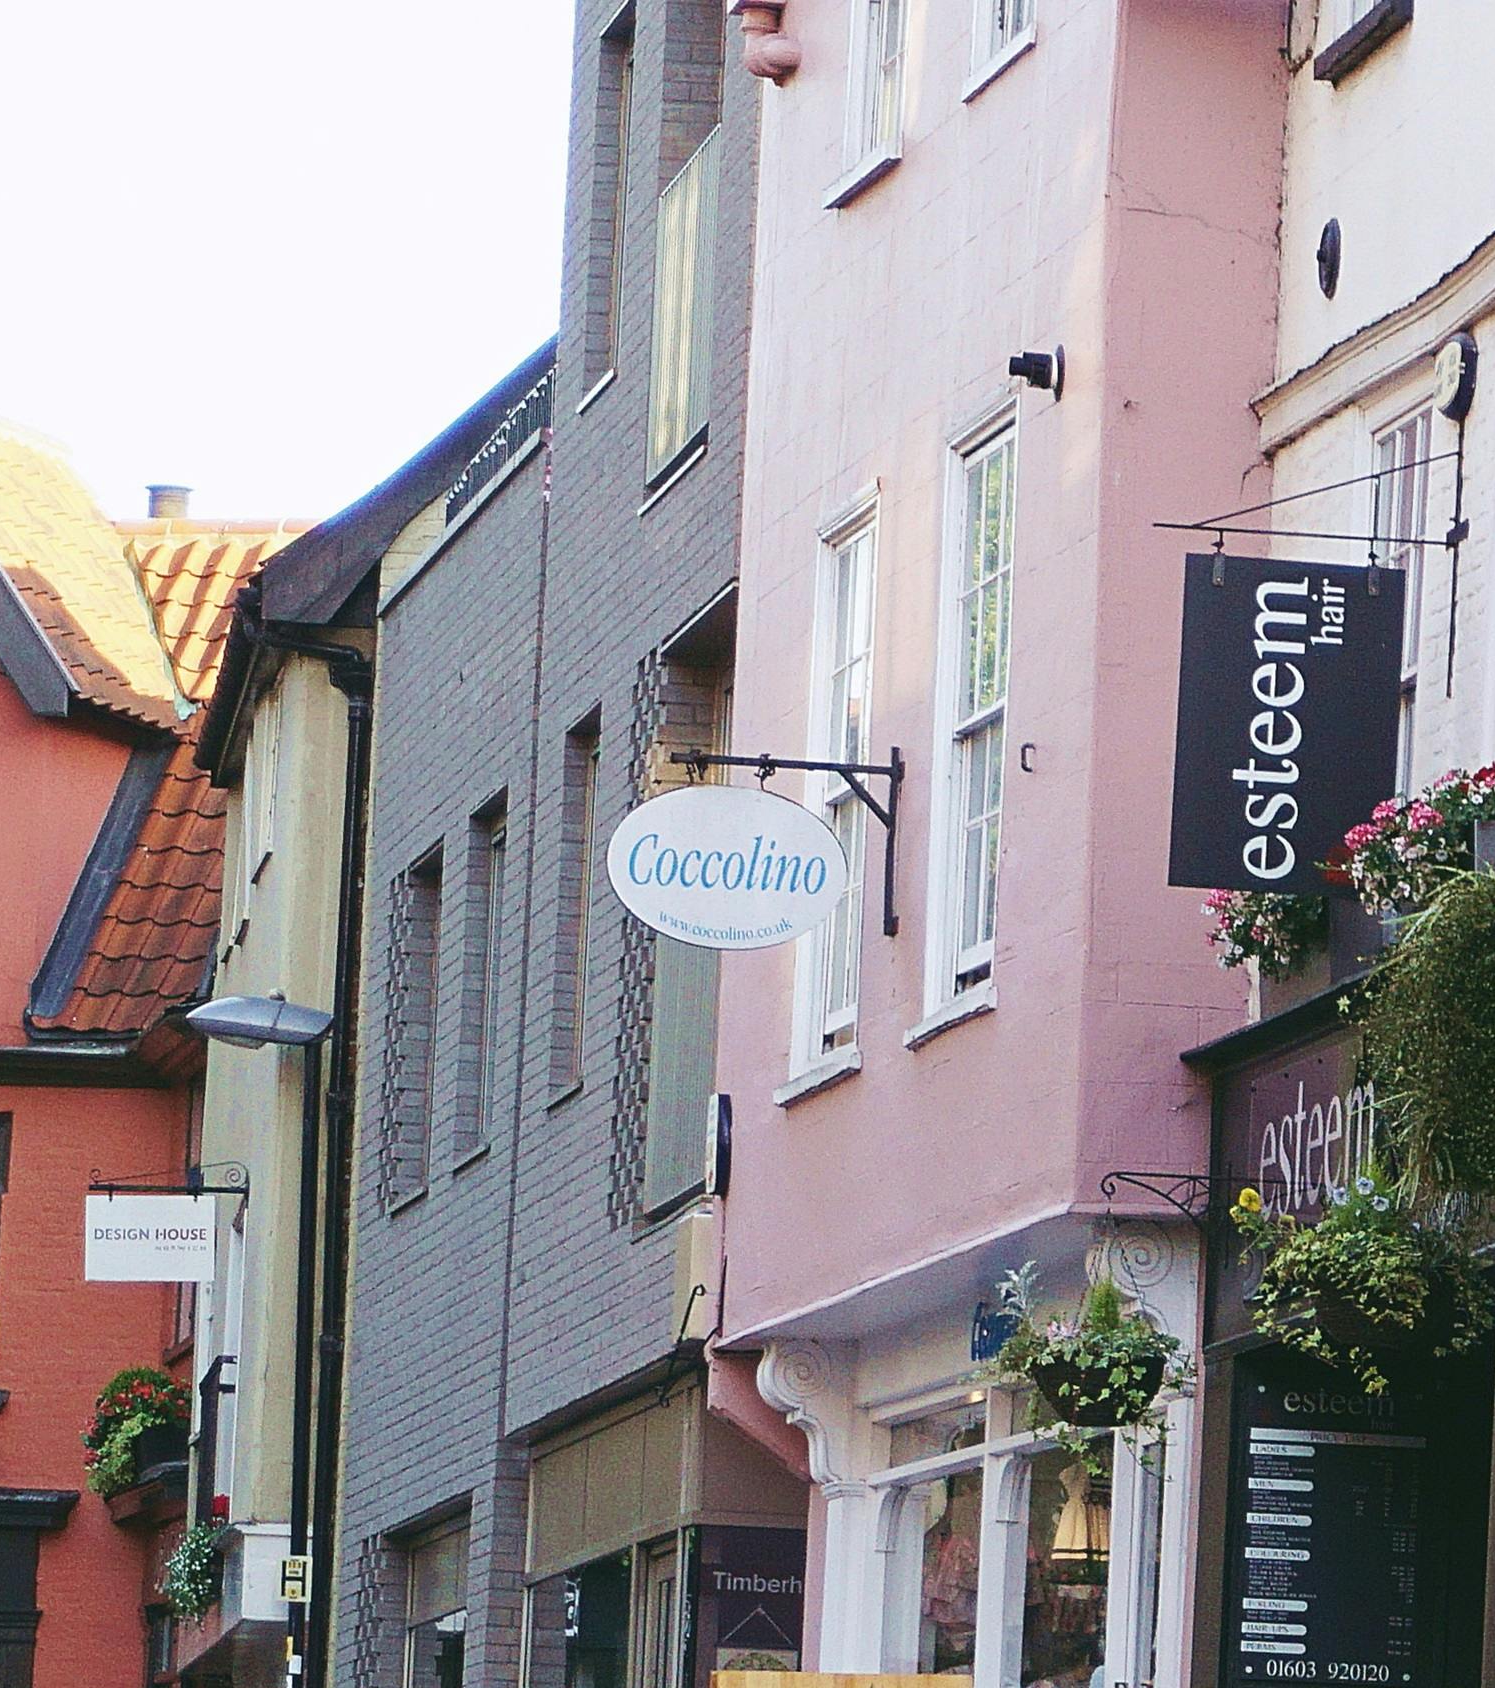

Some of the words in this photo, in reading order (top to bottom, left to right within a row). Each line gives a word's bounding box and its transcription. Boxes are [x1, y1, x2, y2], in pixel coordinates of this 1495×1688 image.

[1310, 578, 1345, 646] hair
[1232, 576, 1309, 880] esteem
[628, 834, 827, 895] Coccolino
[659, 911, 793, 941] www.coccolino.co.uk
[1259, 1079, 1374, 1222] esteem
[94, 1228, 150, 1240] DESIGN
[155, 1228, 207, 1240] HOUSE
[1284, 1388, 1395, 1417] esteem
[1266, 1659, 1317, 1678] 01603
[1328, 1662, 1390, 1682] 920120
